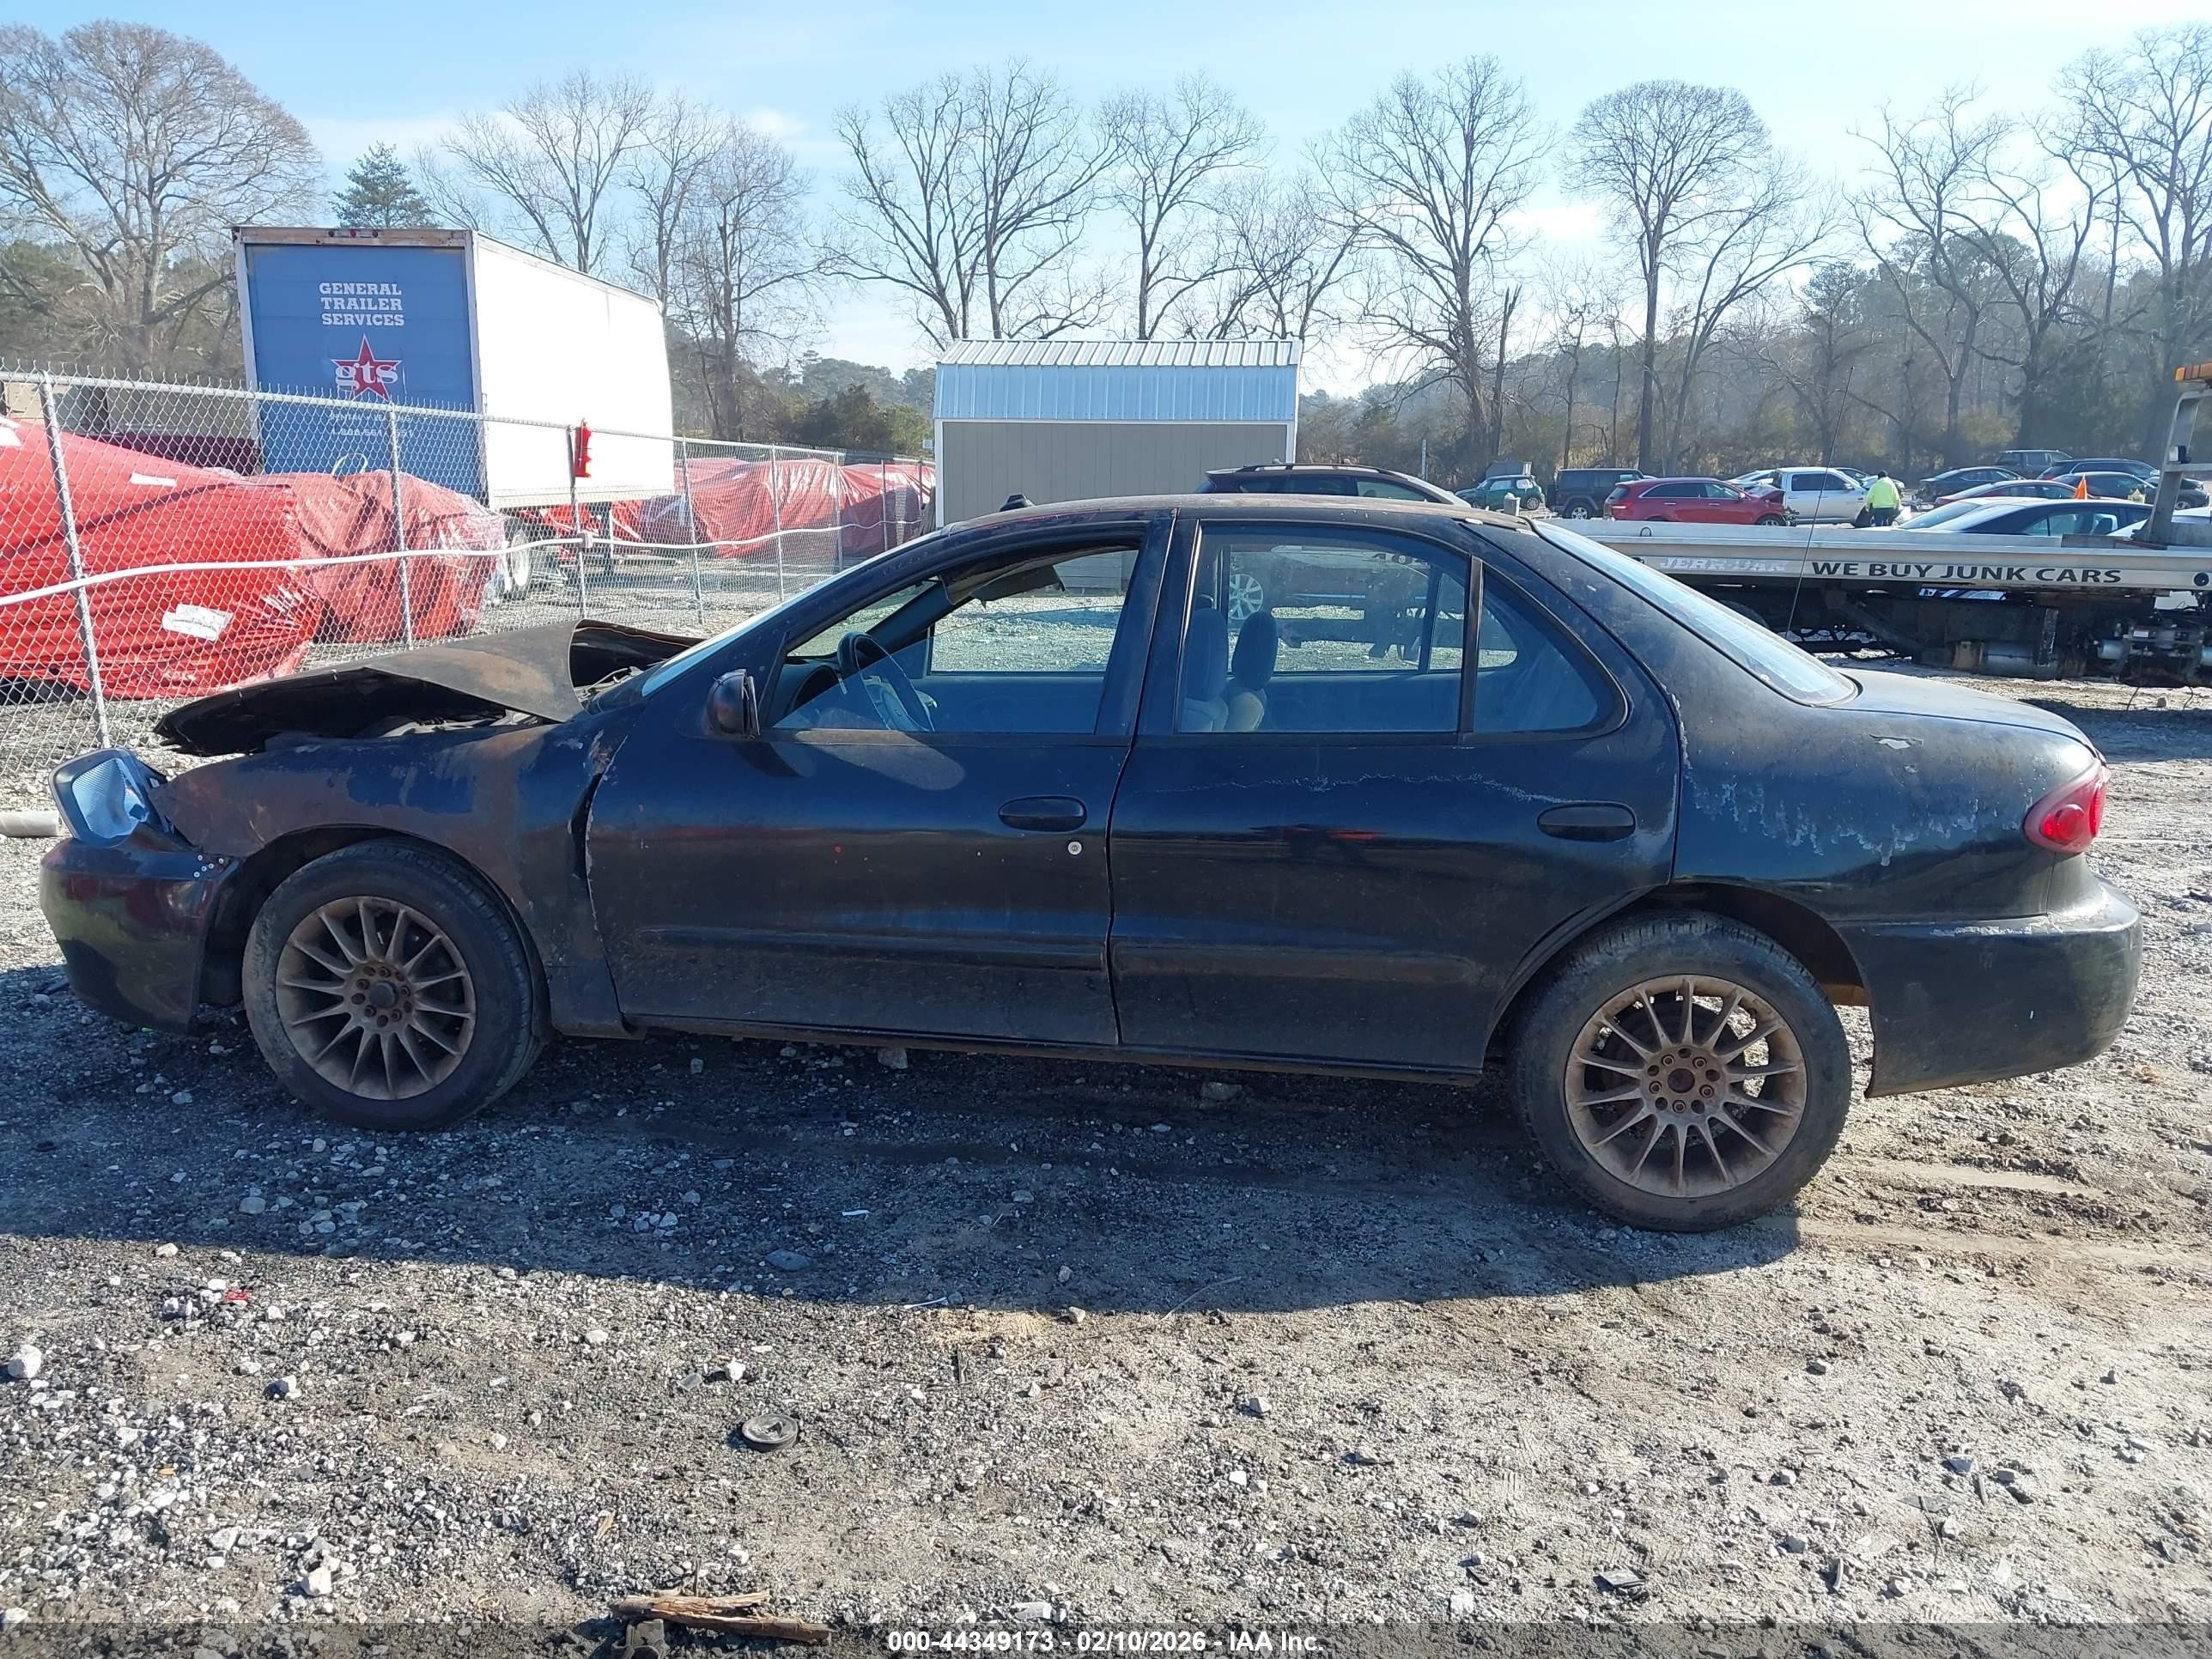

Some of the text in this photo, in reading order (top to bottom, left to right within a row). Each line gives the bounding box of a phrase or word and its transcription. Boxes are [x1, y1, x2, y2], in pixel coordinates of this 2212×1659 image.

[319, 282, 402, 295] GENERAL
[320, 297, 404, 311] TRAILER
[321, 313, 404, 326] SERVICES
[336, 361, 398, 392] gts
[1813, 562, 2123, 584] WE BUY JUNK CARS
